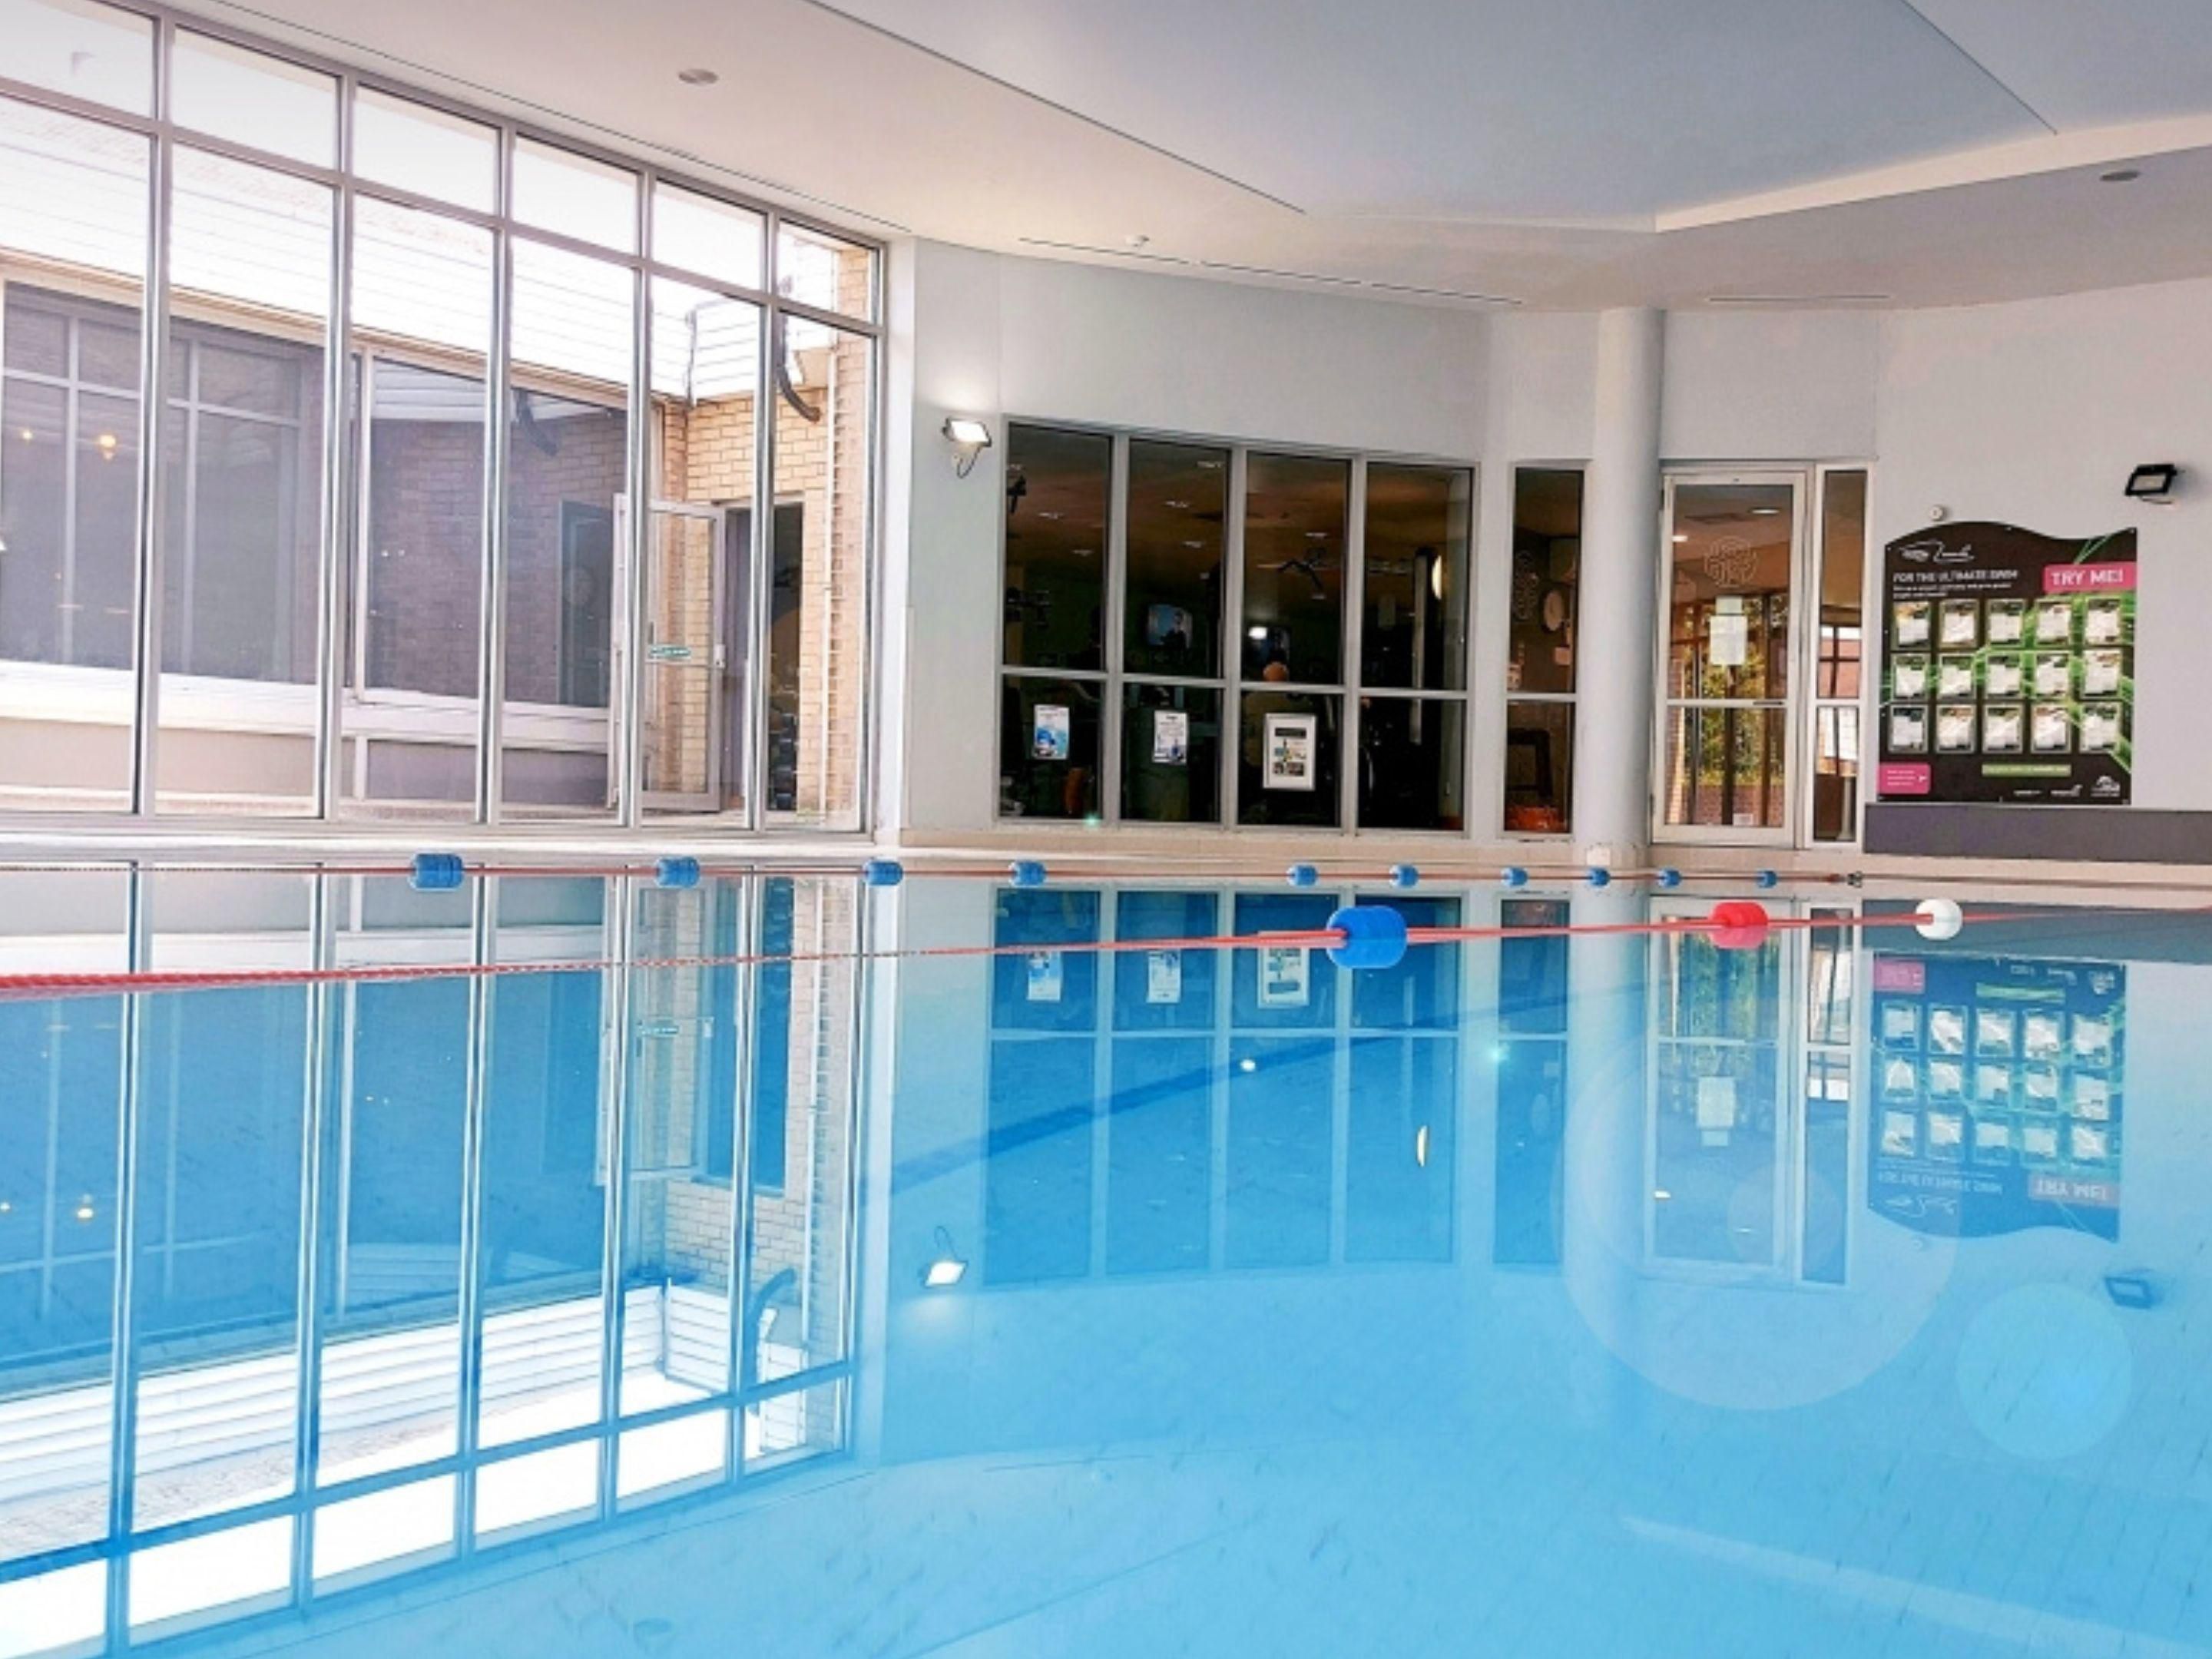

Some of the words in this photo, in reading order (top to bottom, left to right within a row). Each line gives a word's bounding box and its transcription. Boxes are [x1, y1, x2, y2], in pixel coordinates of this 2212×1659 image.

[1892, 571, 1914, 582] FOR
[1916, 571, 1936, 582] THE
[2051, 571, 2086, 585] TRY
[2090, 568, 2124, 584] ME!
